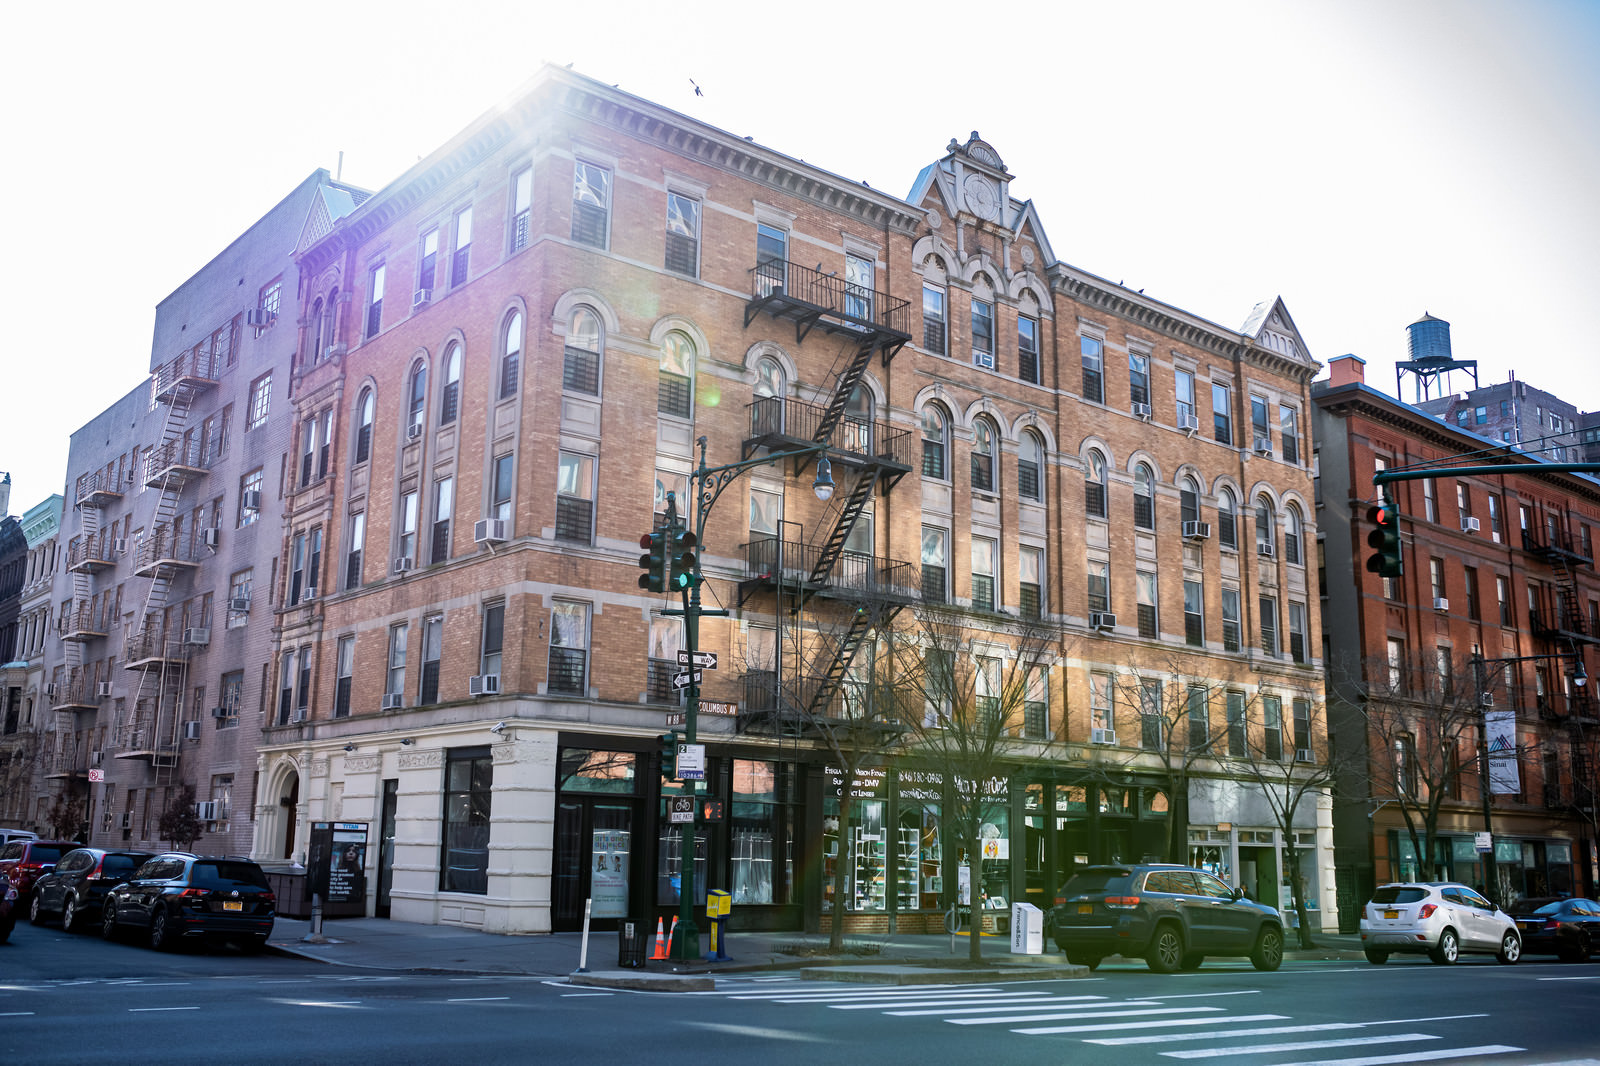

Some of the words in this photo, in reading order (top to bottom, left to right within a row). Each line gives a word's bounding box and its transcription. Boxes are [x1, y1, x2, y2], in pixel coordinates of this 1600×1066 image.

[698, 702, 727, 714] COLUMBUS
[729, 705, 736, 715] AV
[673, 714, 680, 725] 88
[864, 779, 880, 787] DMV
